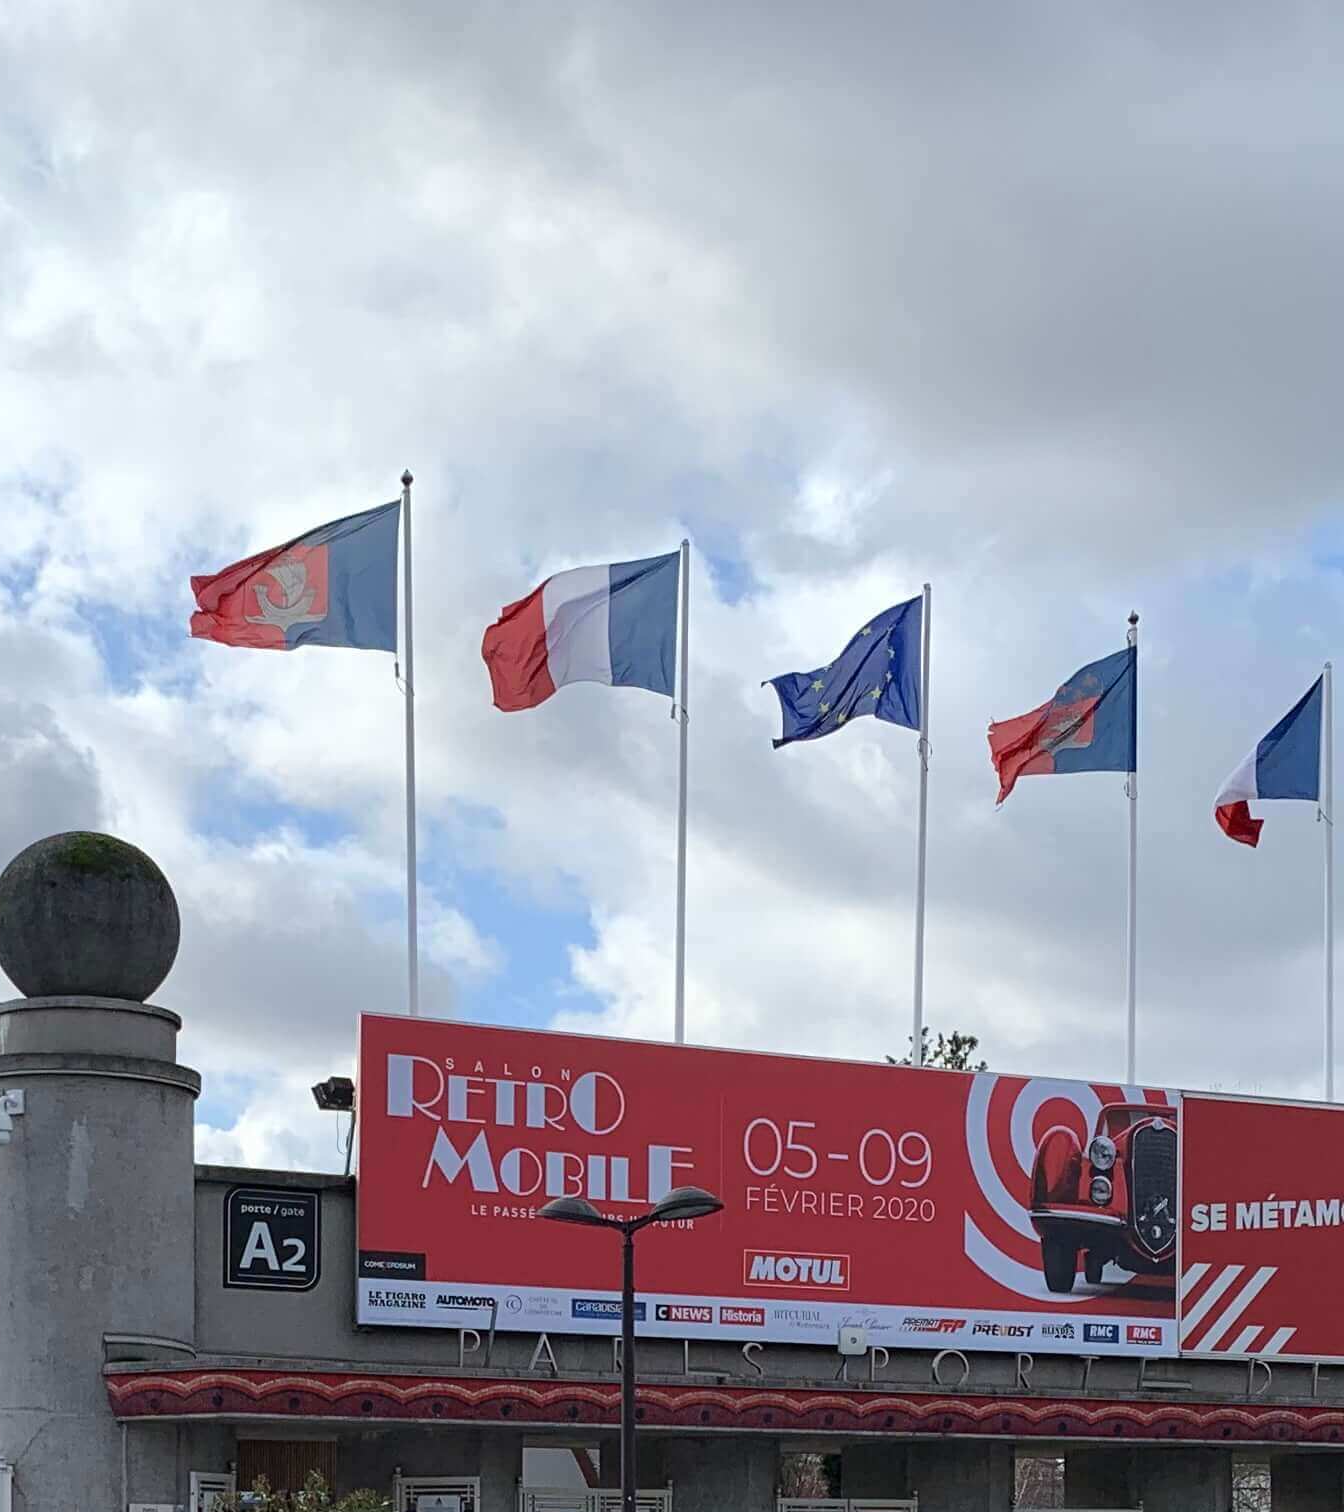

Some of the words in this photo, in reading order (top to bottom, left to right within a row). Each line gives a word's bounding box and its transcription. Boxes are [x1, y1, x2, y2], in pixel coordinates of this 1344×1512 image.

[445, 1057, 572, 1082] SALON
[386, 1053, 626, 1135] RETRO
[421, 1124, 694, 1205] MOBILE
[746, 1183, 864, 1218] FÉVRIER
[872, 1195, 936, 1222] 2020
[241, 1204, 272, 1215] porte
[280, 1207, 305, 1217] gate
[471, 1205, 487, 1216] LE
[493, 1206, 537, 1219] PASSÉ
[1190, 1203, 1227, 1232] SE
[239, 1221, 306, 1272] A2
[749, 1255, 845, 1285] MOTUL
[368, 1290, 383, 1300] LE
[385, 1291, 426, 1301] FIGARO
[436, 1294, 496, 1307] AUTOMOTO
[368, 1299, 426, 1309] MAGAZINE
[659, 1306, 668, 1319] C
[672, 1308, 711, 1321] NEWS
[721, 1309, 762, 1323] Historia
[1089, 1325, 1113, 1337] RMC
[1133, 1327, 1156, 1339] RMC
